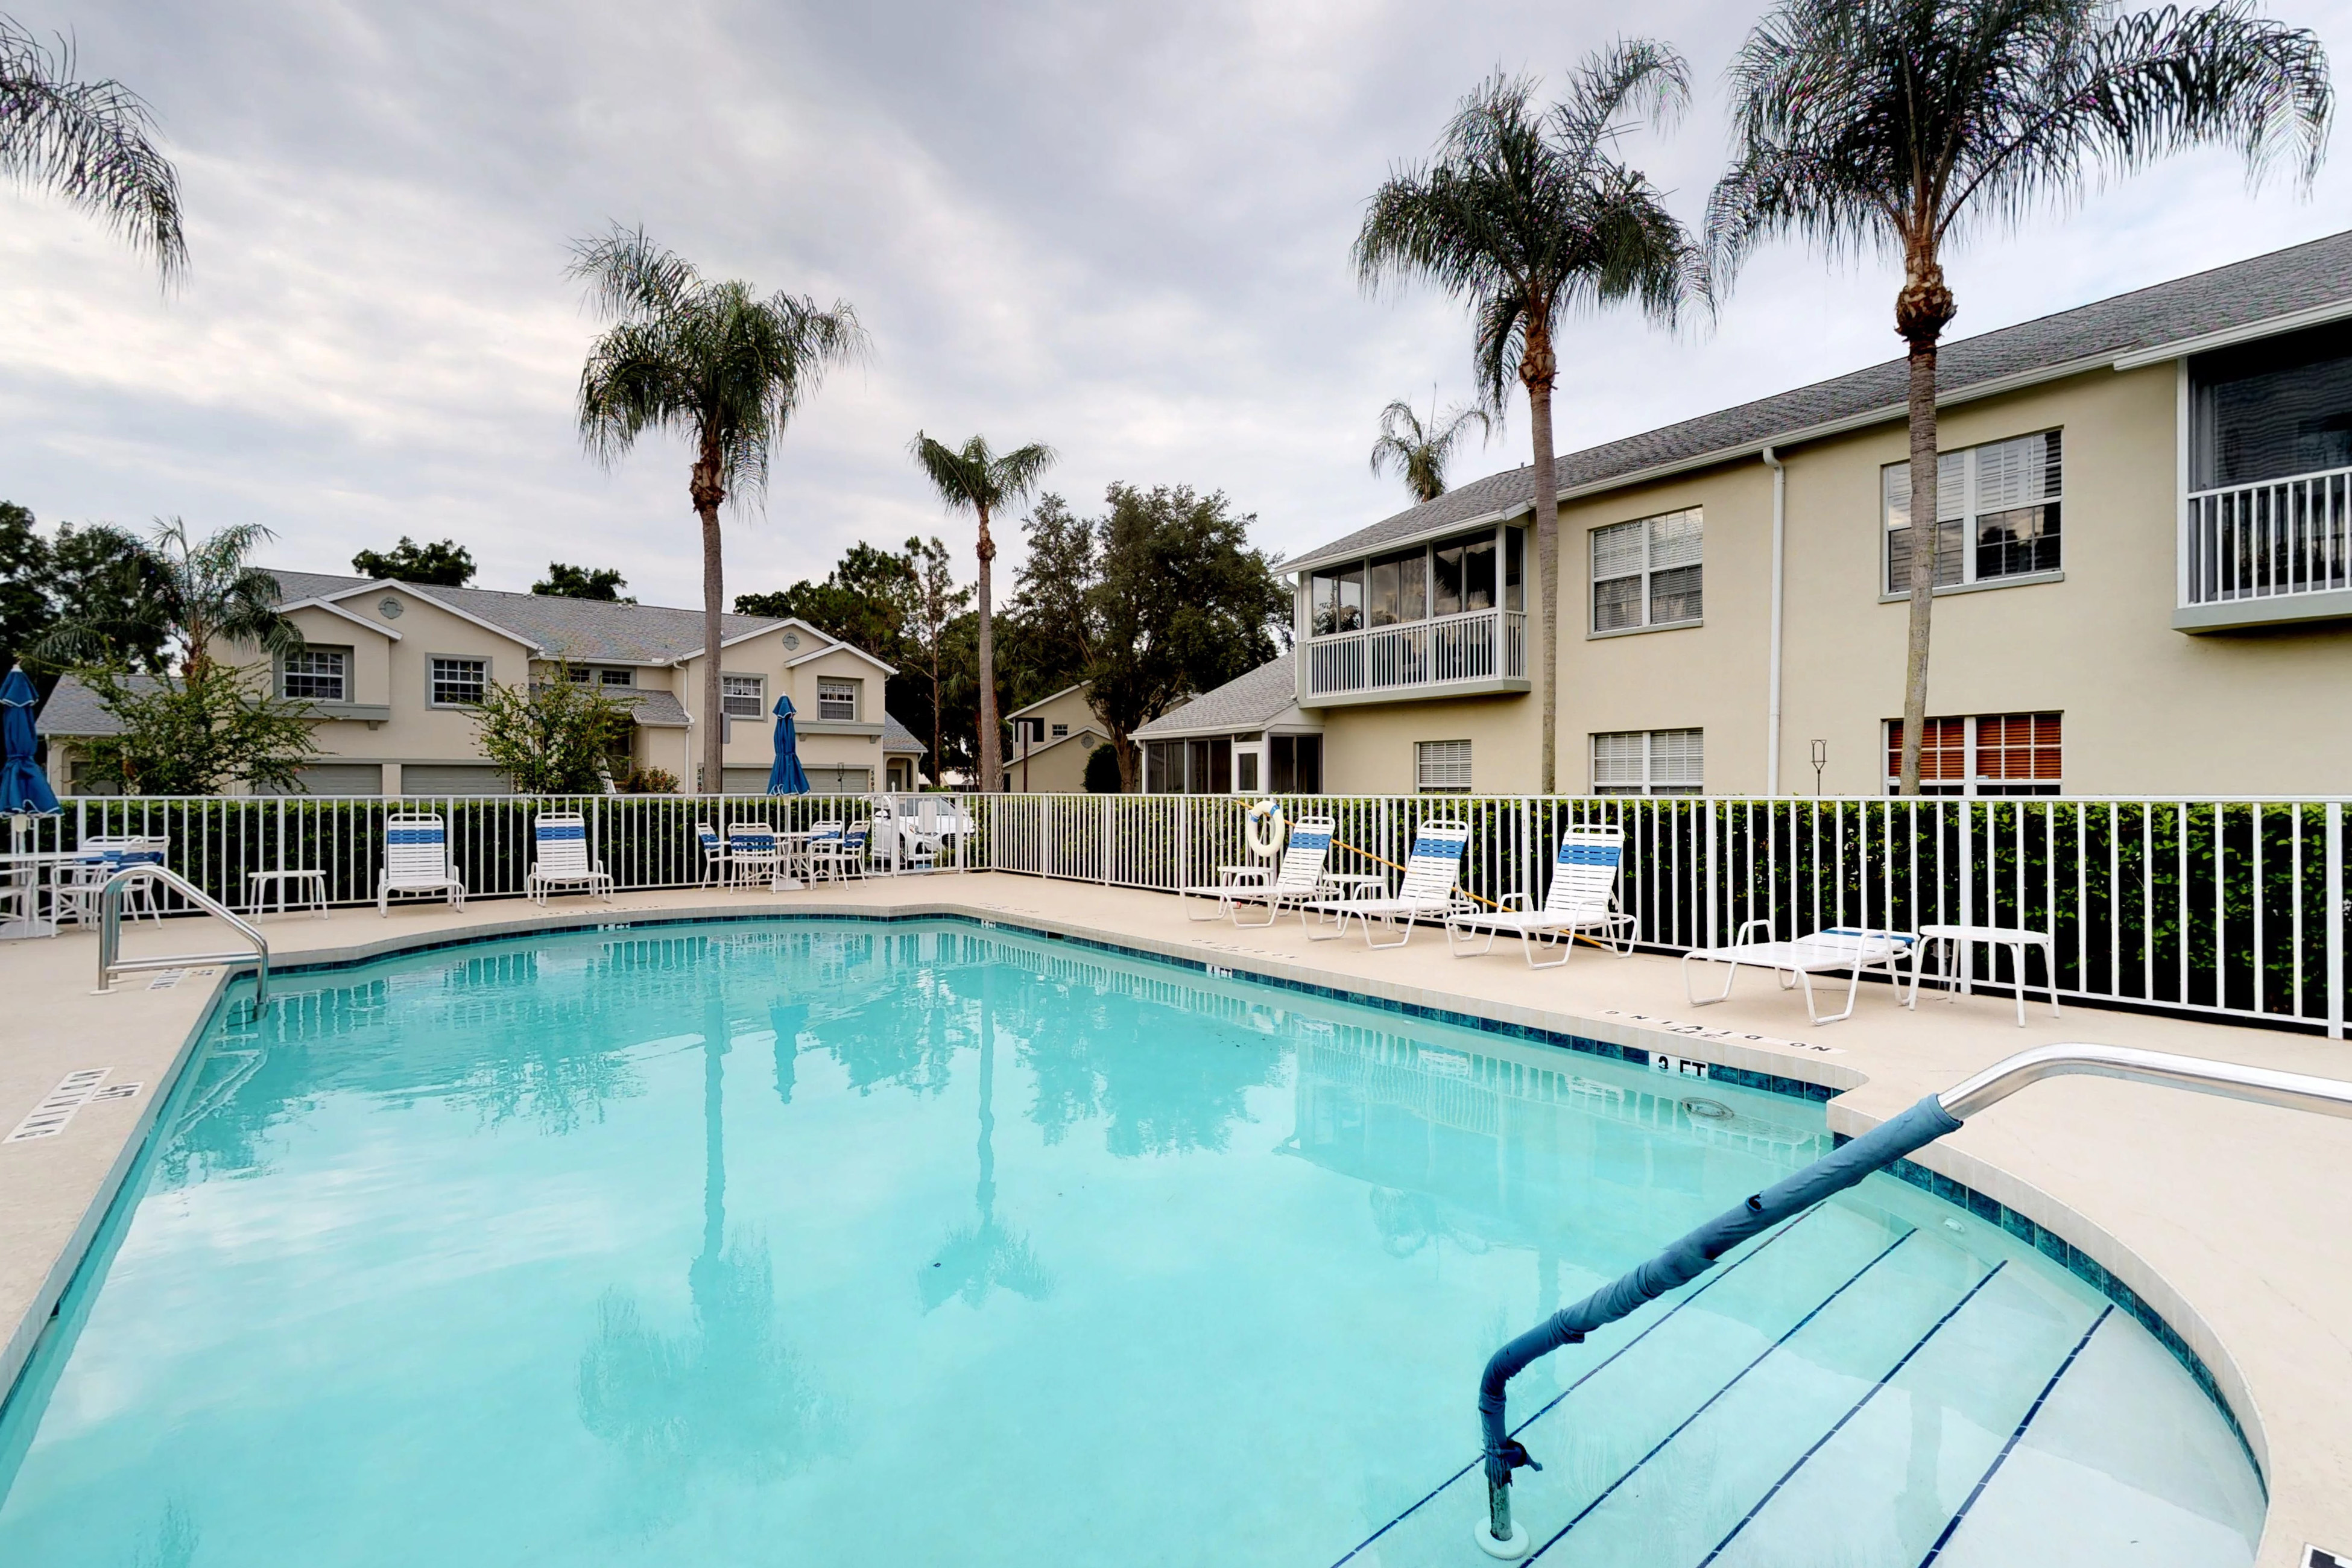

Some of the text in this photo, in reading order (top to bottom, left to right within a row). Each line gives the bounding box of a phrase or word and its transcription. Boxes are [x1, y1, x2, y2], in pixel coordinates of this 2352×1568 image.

[1604, 1010, 1831, 1052] NO DIVING
[1658, 1055, 1706, 1077] 3 FT
[14, 1069, 107, 1139] NO DIVING
